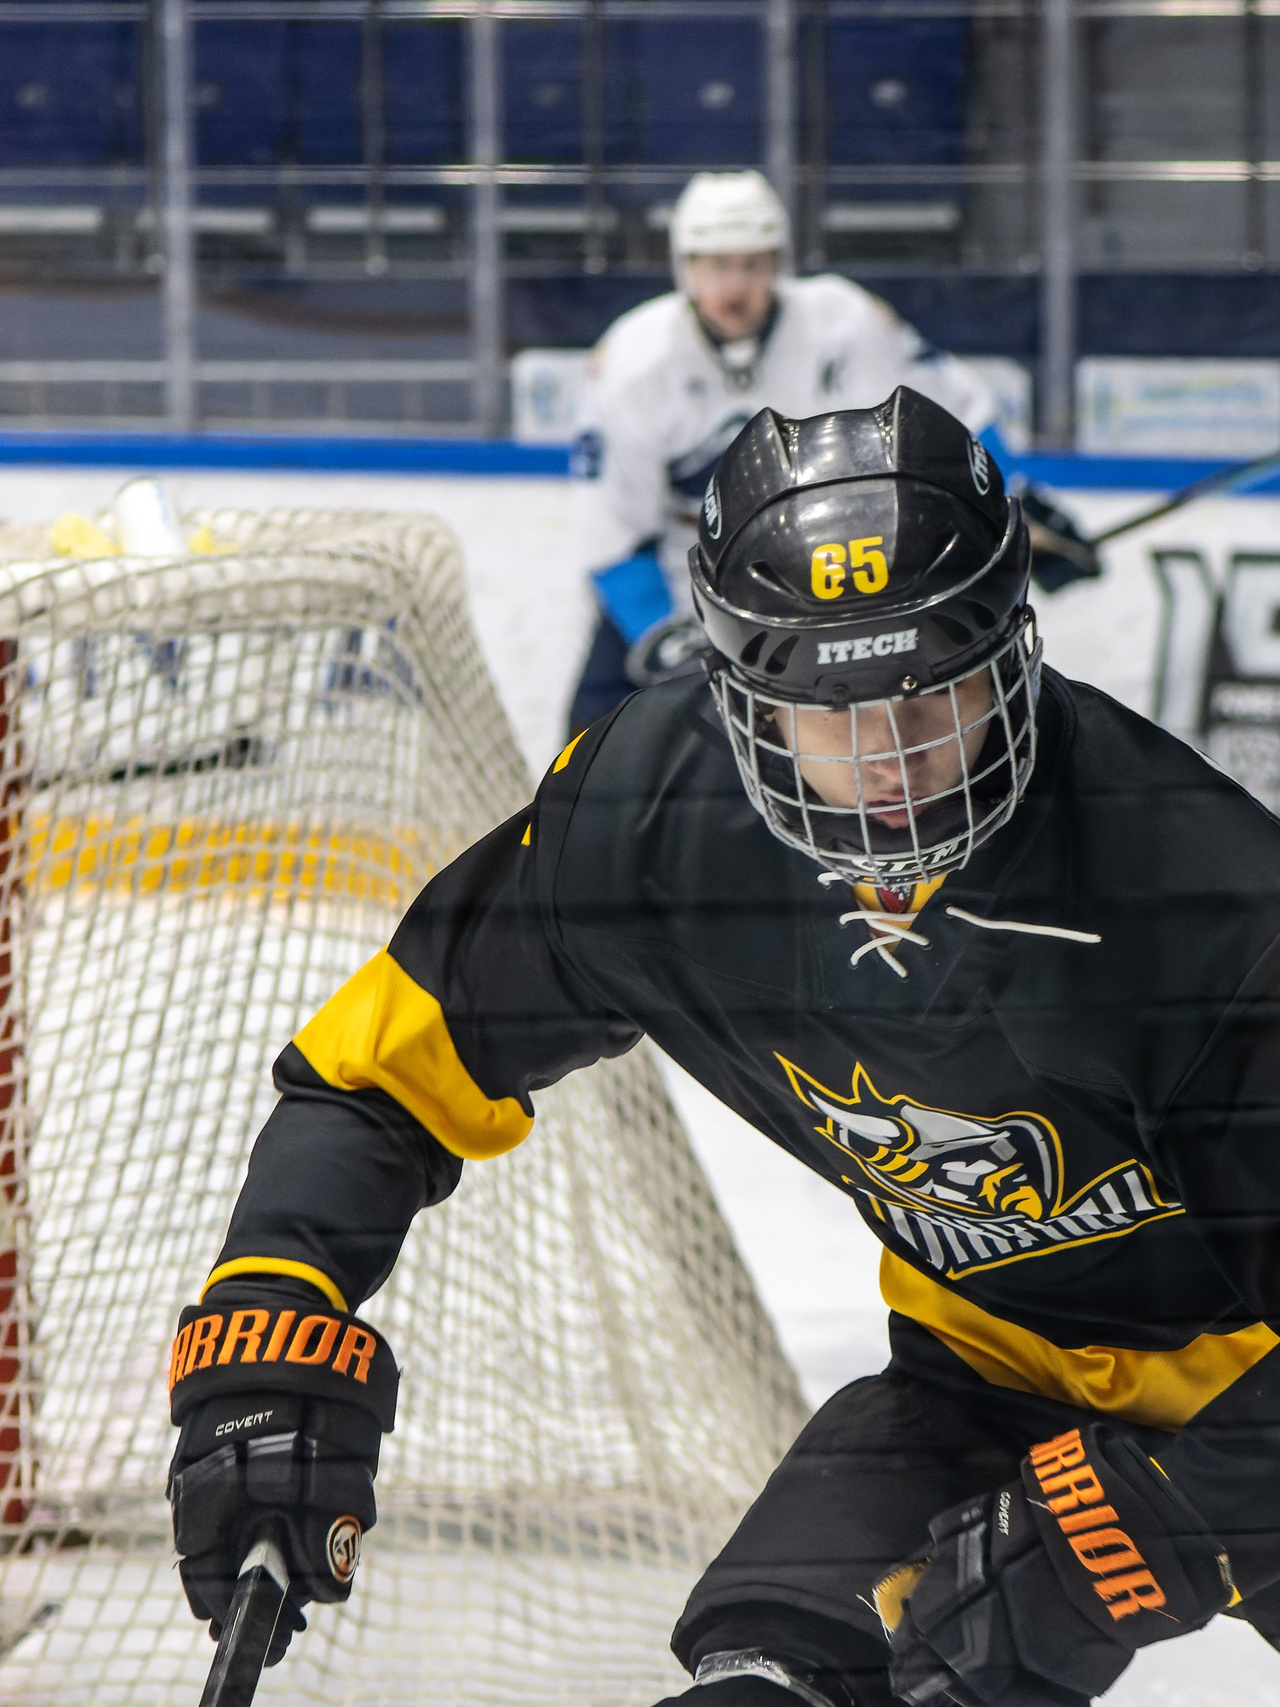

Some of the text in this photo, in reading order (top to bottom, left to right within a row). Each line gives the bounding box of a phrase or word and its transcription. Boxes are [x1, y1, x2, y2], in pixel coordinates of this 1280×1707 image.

[811, 536, 889, 600] 65
[817, 627, 919, 665] ITECH
[169, 1309, 378, 1391] ARRIOR
[215, 1409, 274, 1437] COVERT
